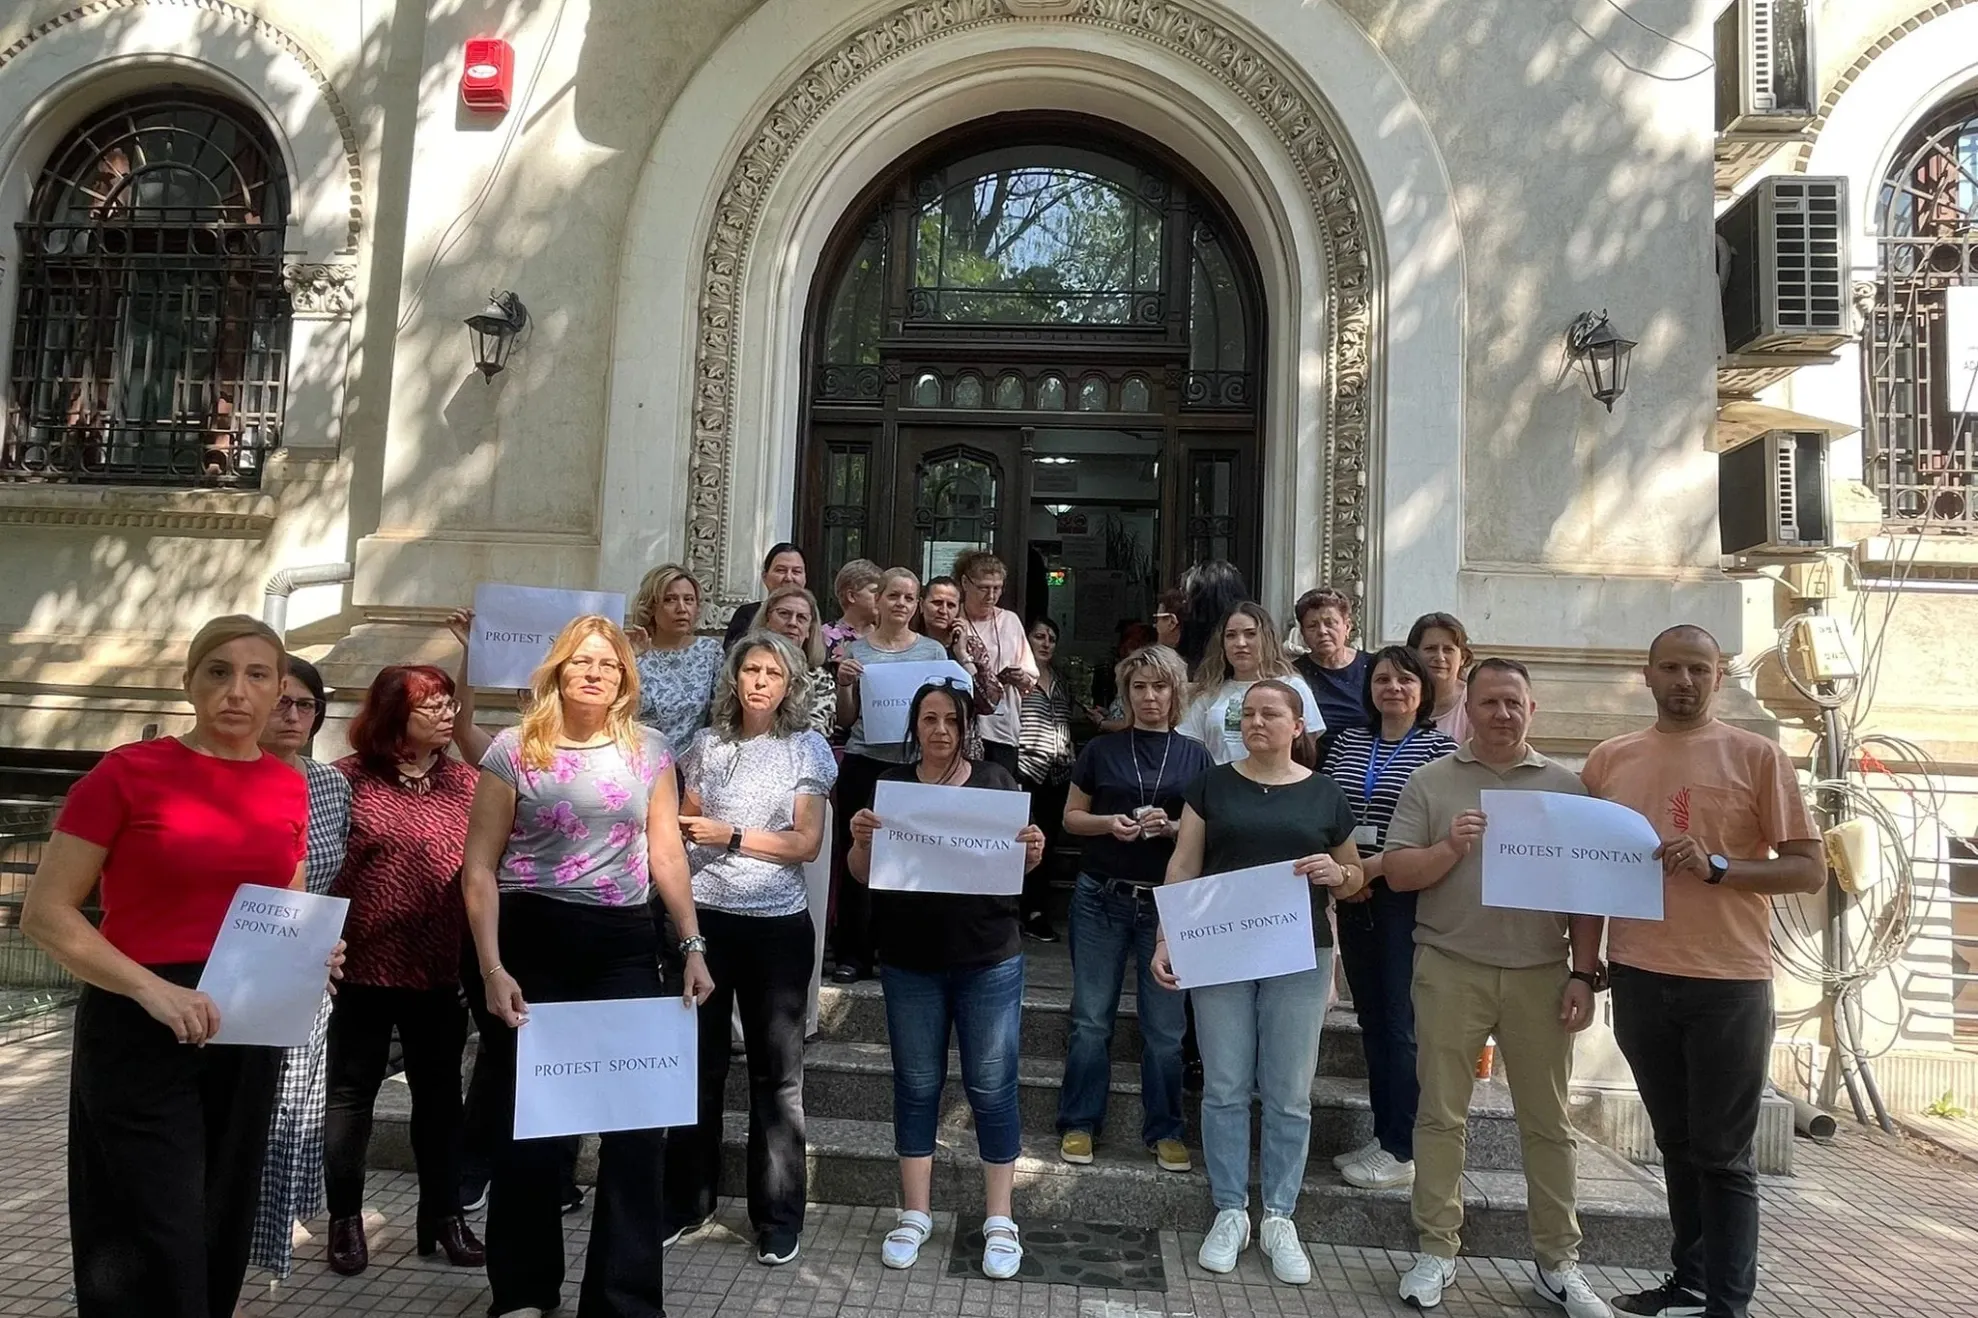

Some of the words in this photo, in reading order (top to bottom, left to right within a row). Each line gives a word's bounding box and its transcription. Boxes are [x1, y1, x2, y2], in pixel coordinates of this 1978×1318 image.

[485, 631, 542, 644] PROTEST
[889, 830, 944, 846] PROTEST
[950, 836, 1011, 851] SPONTAN
[1500, 843, 1564, 858] PROTEST
[1571, 848, 1643, 863] SPONTAN
[239, 900, 301, 920] PROTEST
[233, 918, 300, 938] SPONTAN
[1180, 922, 1234, 941] PROTEST
[1240, 911, 1298, 931] SPONTAN
[534, 1060, 601, 1077] PROTEST
[609, 1055, 679, 1072] SPONTAN
